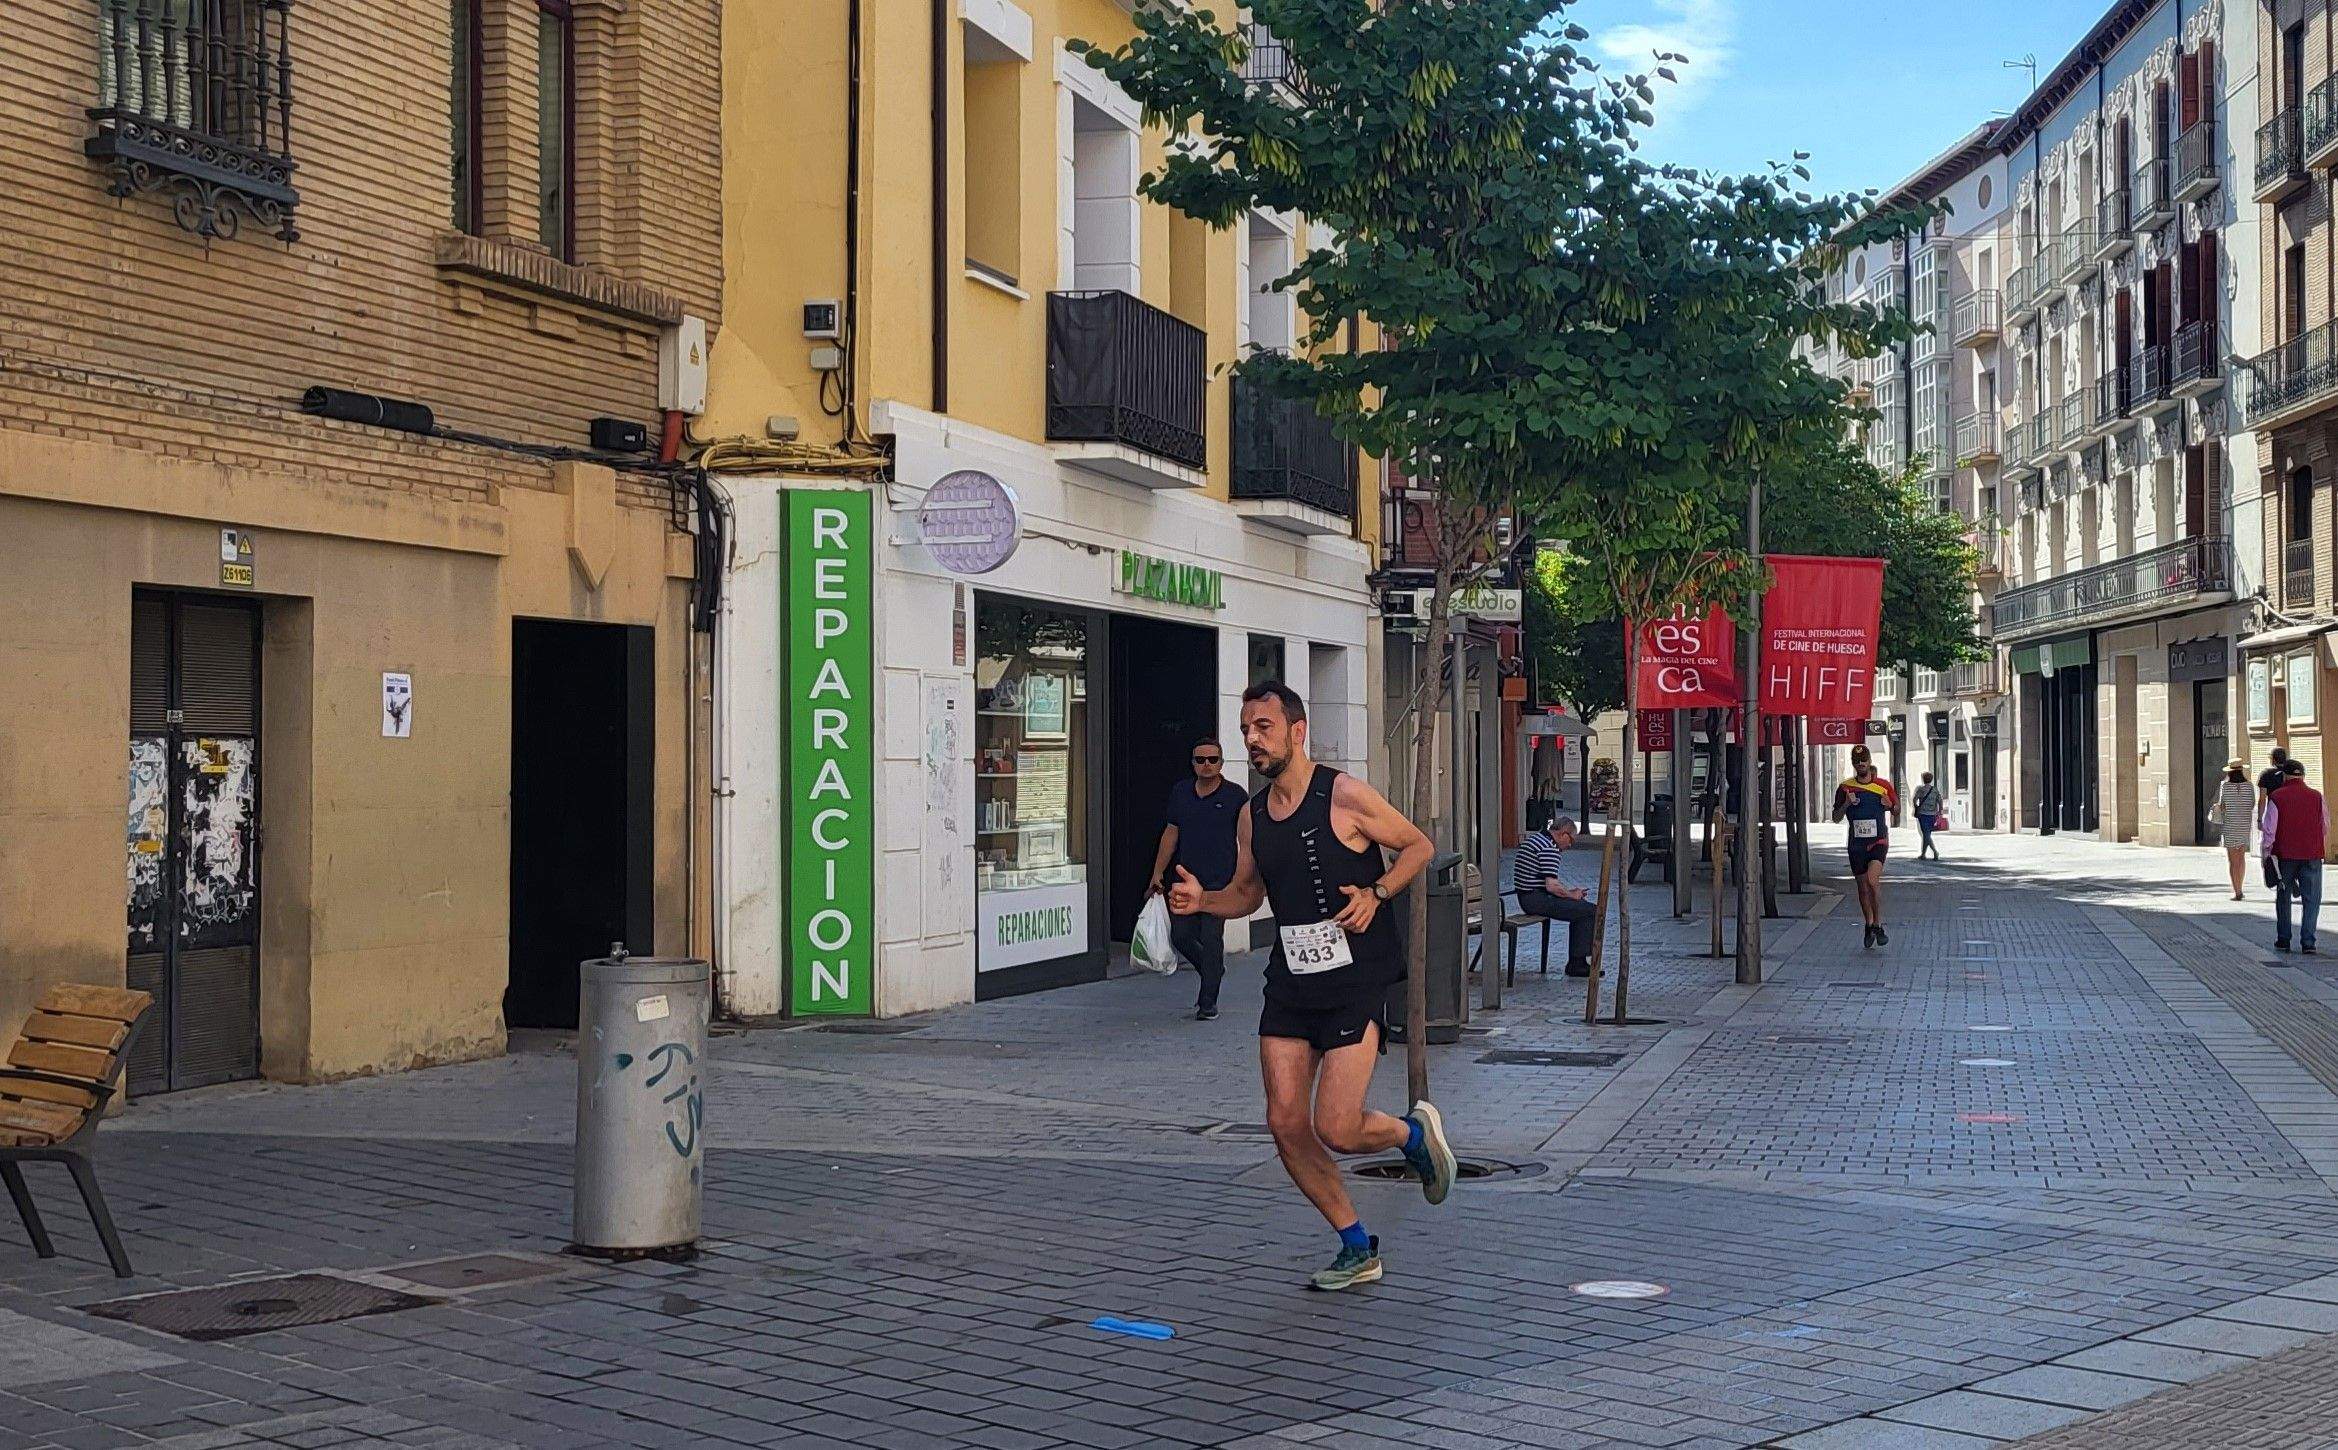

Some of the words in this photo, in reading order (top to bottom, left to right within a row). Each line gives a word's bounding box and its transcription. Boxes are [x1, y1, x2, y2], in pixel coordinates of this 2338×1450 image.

[1656, 624, 1701, 654] es
[1774, 629, 1807, 638] FESTIVAL
[1808, 628, 1866, 638] INTERNACIONAL
[1773, 640, 1786, 650] DE
[1788, 641, 1811, 652] CINE
[1812, 642, 1826, 653] DE
[1827, 643, 1866, 655] HUESCA
[1657, 667, 1705, 693] ca
[1770, 664, 1865, 702] HIFF
[1823, 722, 1848, 737] ca
[809, 508, 851, 1001] REPARACION
[997, 905, 1072, 946] REPARACIONES
[1298, 946, 1334, 964] 433
